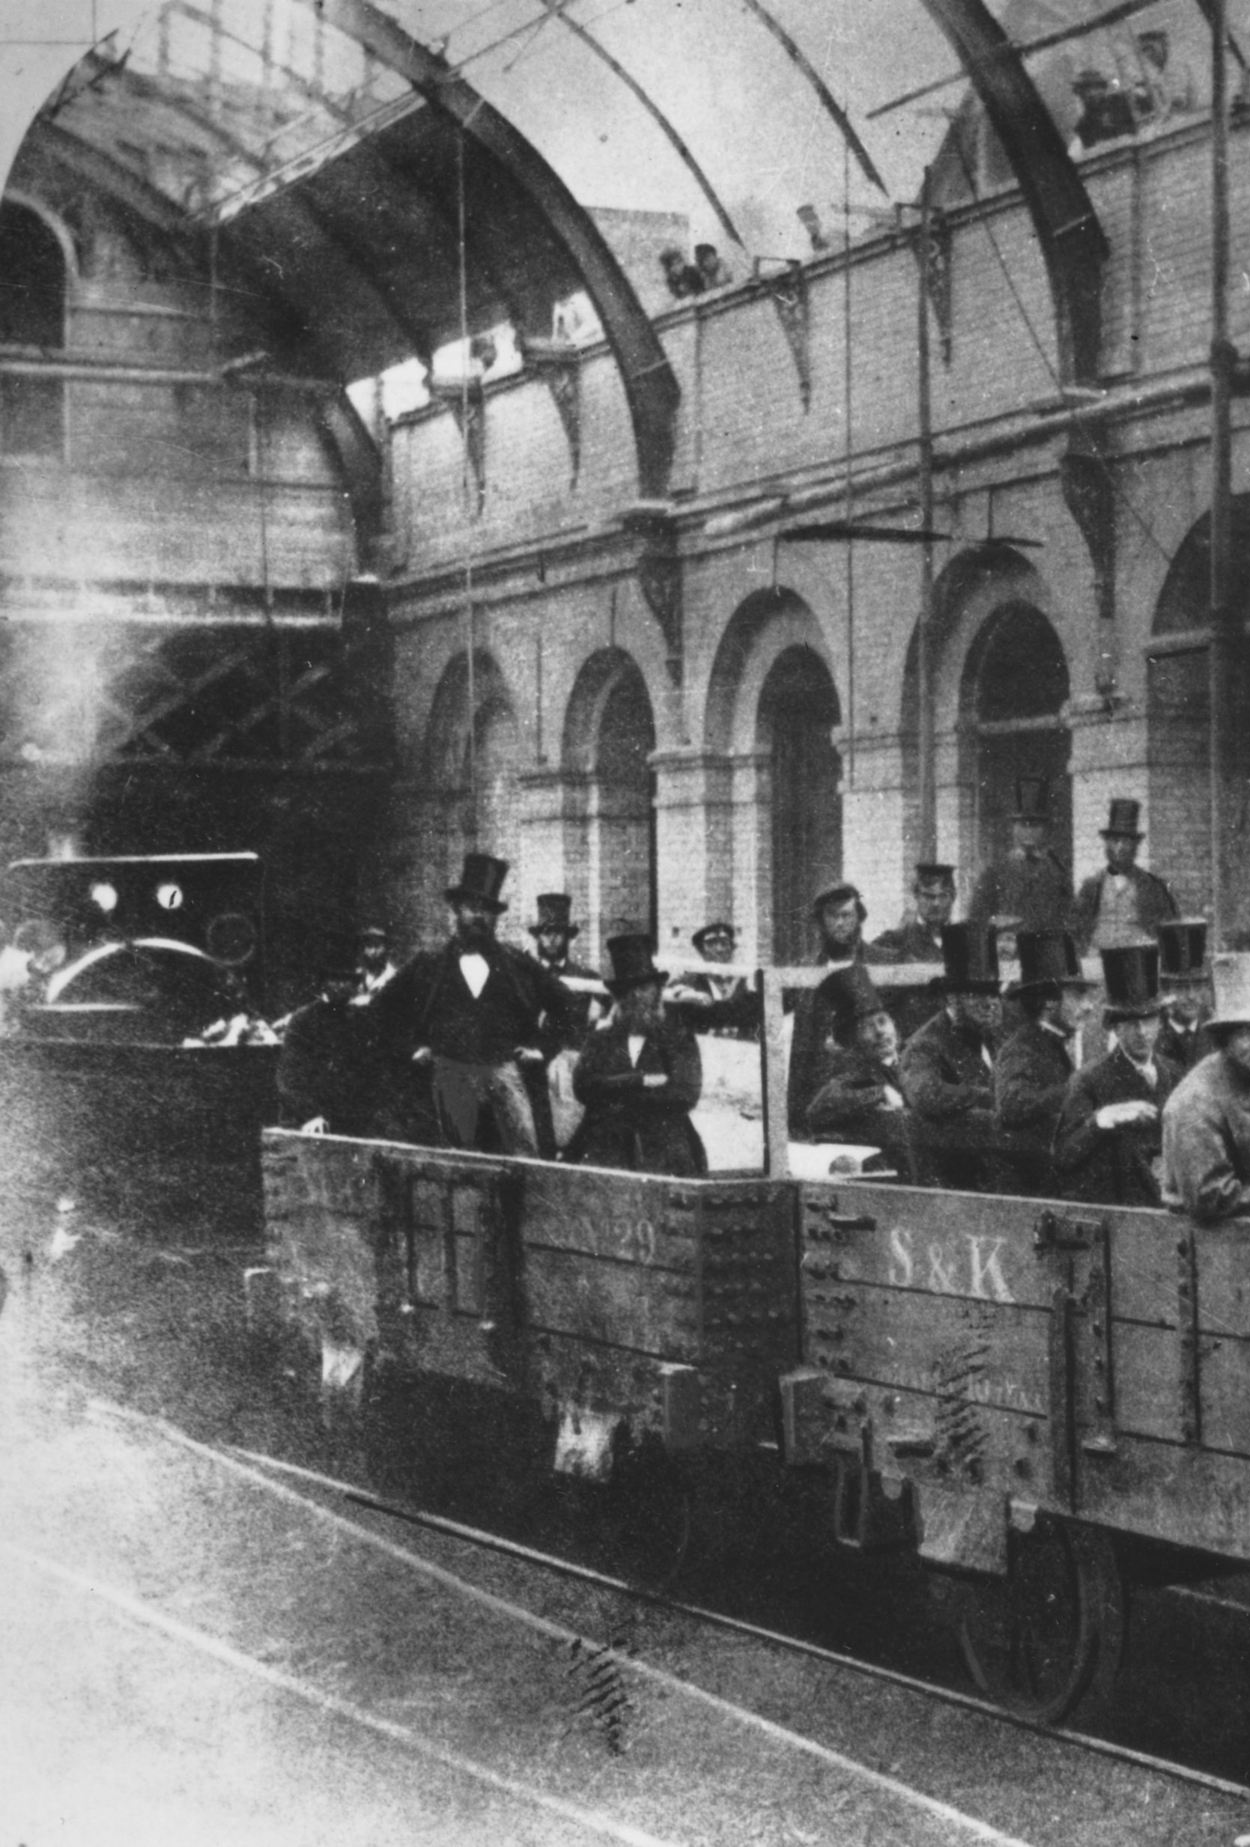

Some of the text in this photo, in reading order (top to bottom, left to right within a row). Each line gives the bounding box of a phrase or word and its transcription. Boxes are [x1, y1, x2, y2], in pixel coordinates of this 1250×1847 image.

[889, 1228, 1016, 1303] S & K
